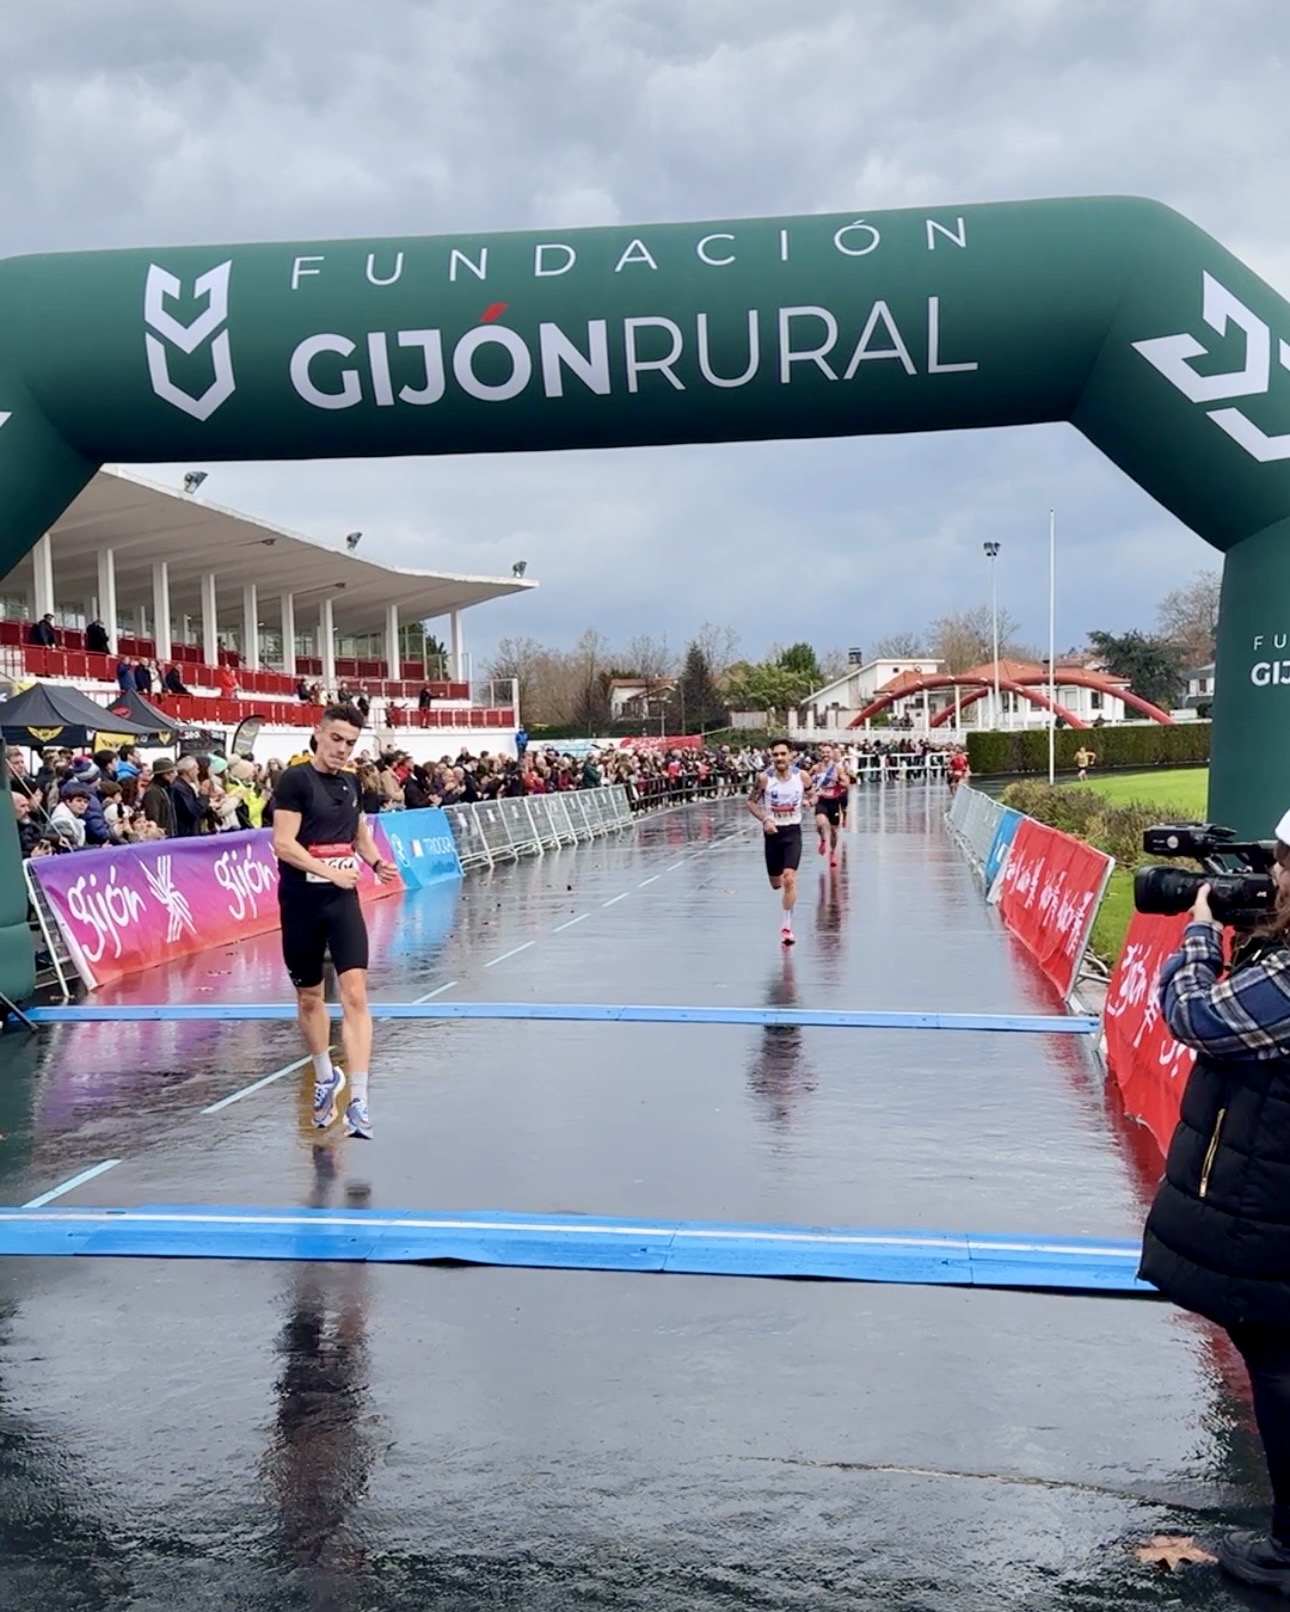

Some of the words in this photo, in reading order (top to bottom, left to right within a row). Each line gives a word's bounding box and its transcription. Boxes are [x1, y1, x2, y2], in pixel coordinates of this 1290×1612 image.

[291, 217, 966, 290] FUNDACIÓN
[289, 296, 979, 410] GIJÓNRURAL
[1253, 633, 1287, 651] FU
[67, 864, 147, 963] gijón
[214, 843, 277, 920] gijón
